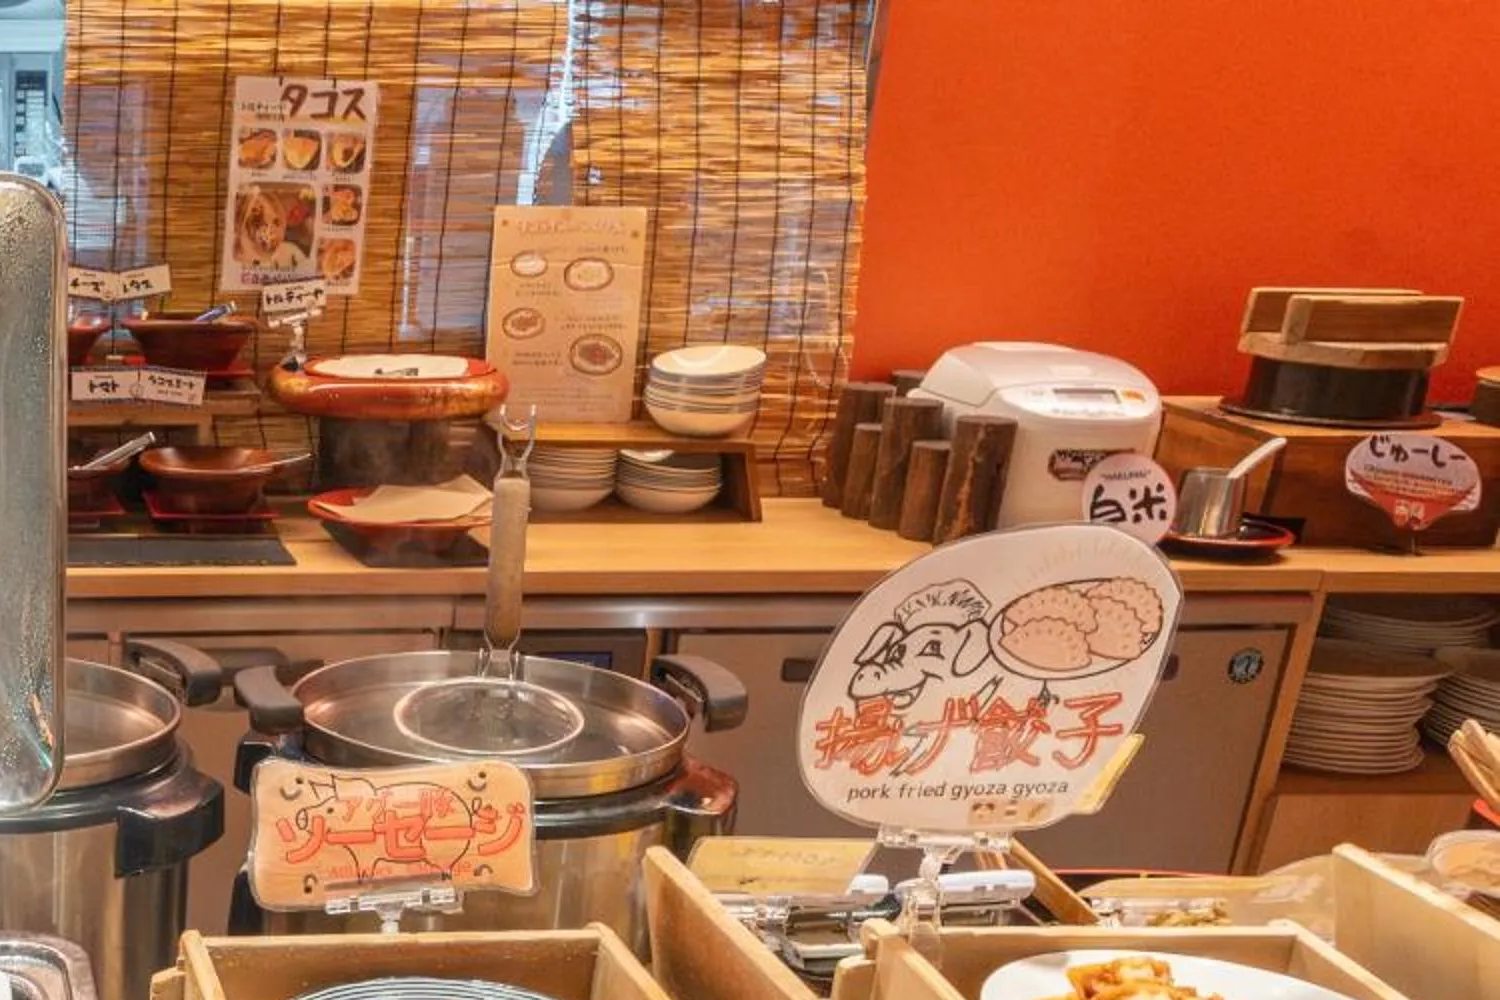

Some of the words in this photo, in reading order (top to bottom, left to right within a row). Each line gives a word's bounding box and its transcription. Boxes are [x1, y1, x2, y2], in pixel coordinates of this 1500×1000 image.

[280, 83, 366, 121] タコス
[88, 379, 120, 394] トマト
[1369, 434, 1467, 469] じゅーしー
[1089, 482, 1167, 524] 白米
[814, 691, 1124, 777] 揚げ餃子
[847, 782, 891, 803] pork
[899, 780, 946, 799] fried
[950, 780, 1007, 801] gyoza
[1012, 778, 1069, 797] gyoza
